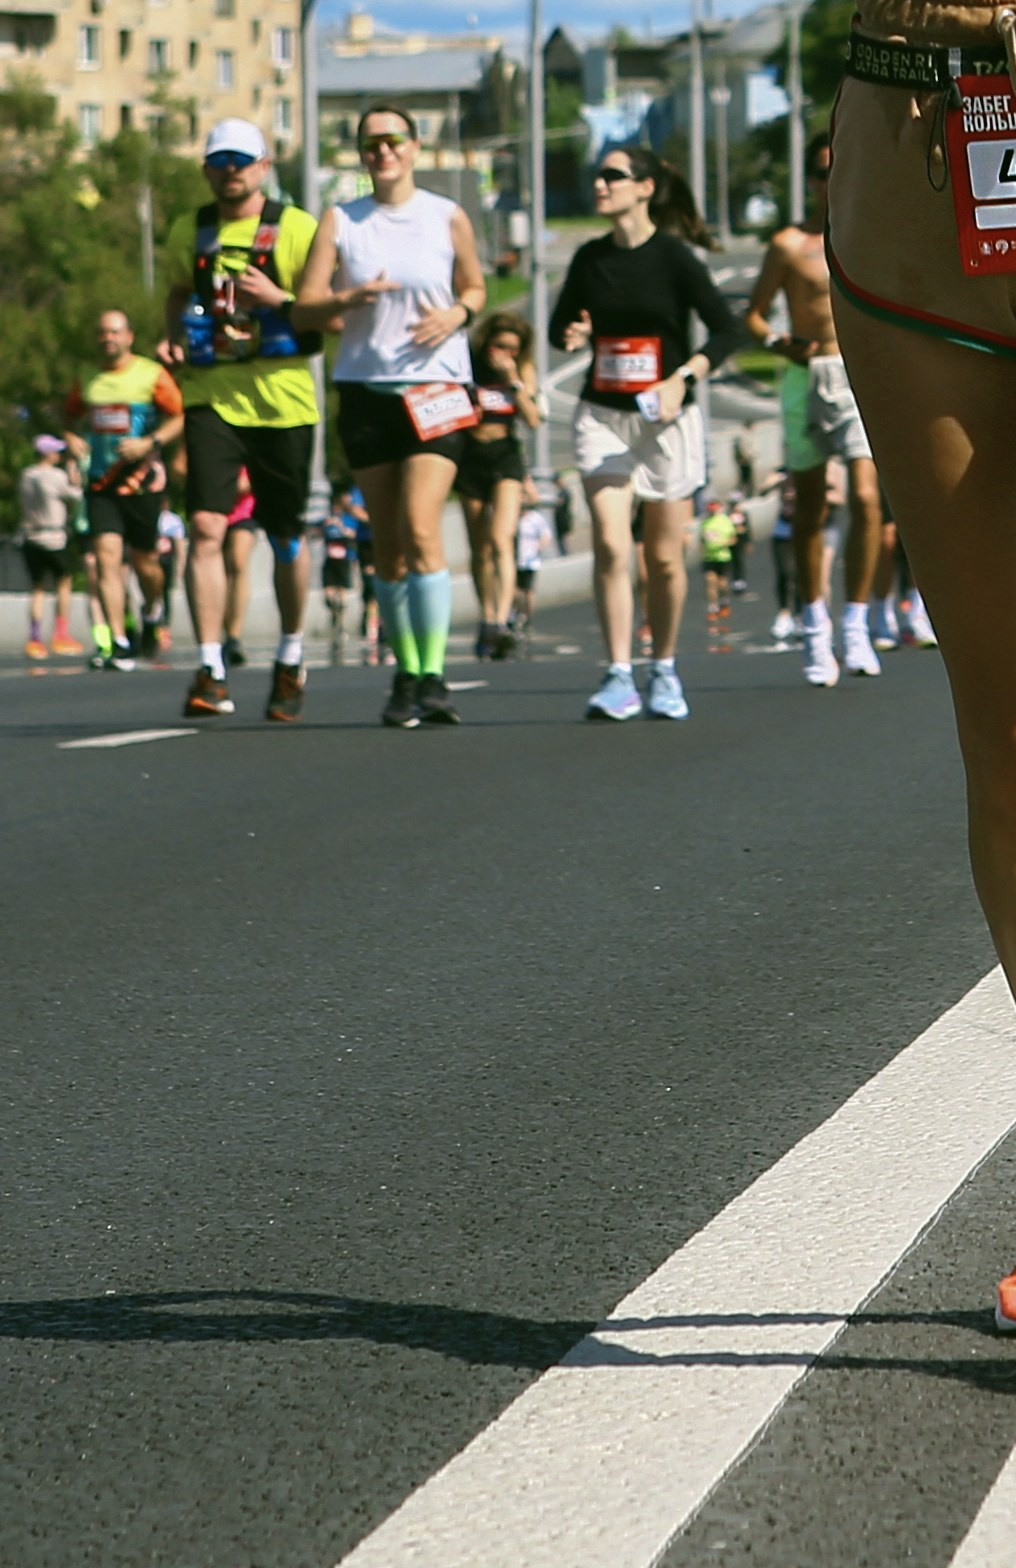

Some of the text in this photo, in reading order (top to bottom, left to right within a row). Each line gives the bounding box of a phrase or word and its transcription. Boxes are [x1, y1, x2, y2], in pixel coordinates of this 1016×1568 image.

[856, 43, 911, 67] GOLDEN
[855, 59, 931, 81] ULTRA TRAIL
[962, 95, 1011, 114] ЗАБЕГ
